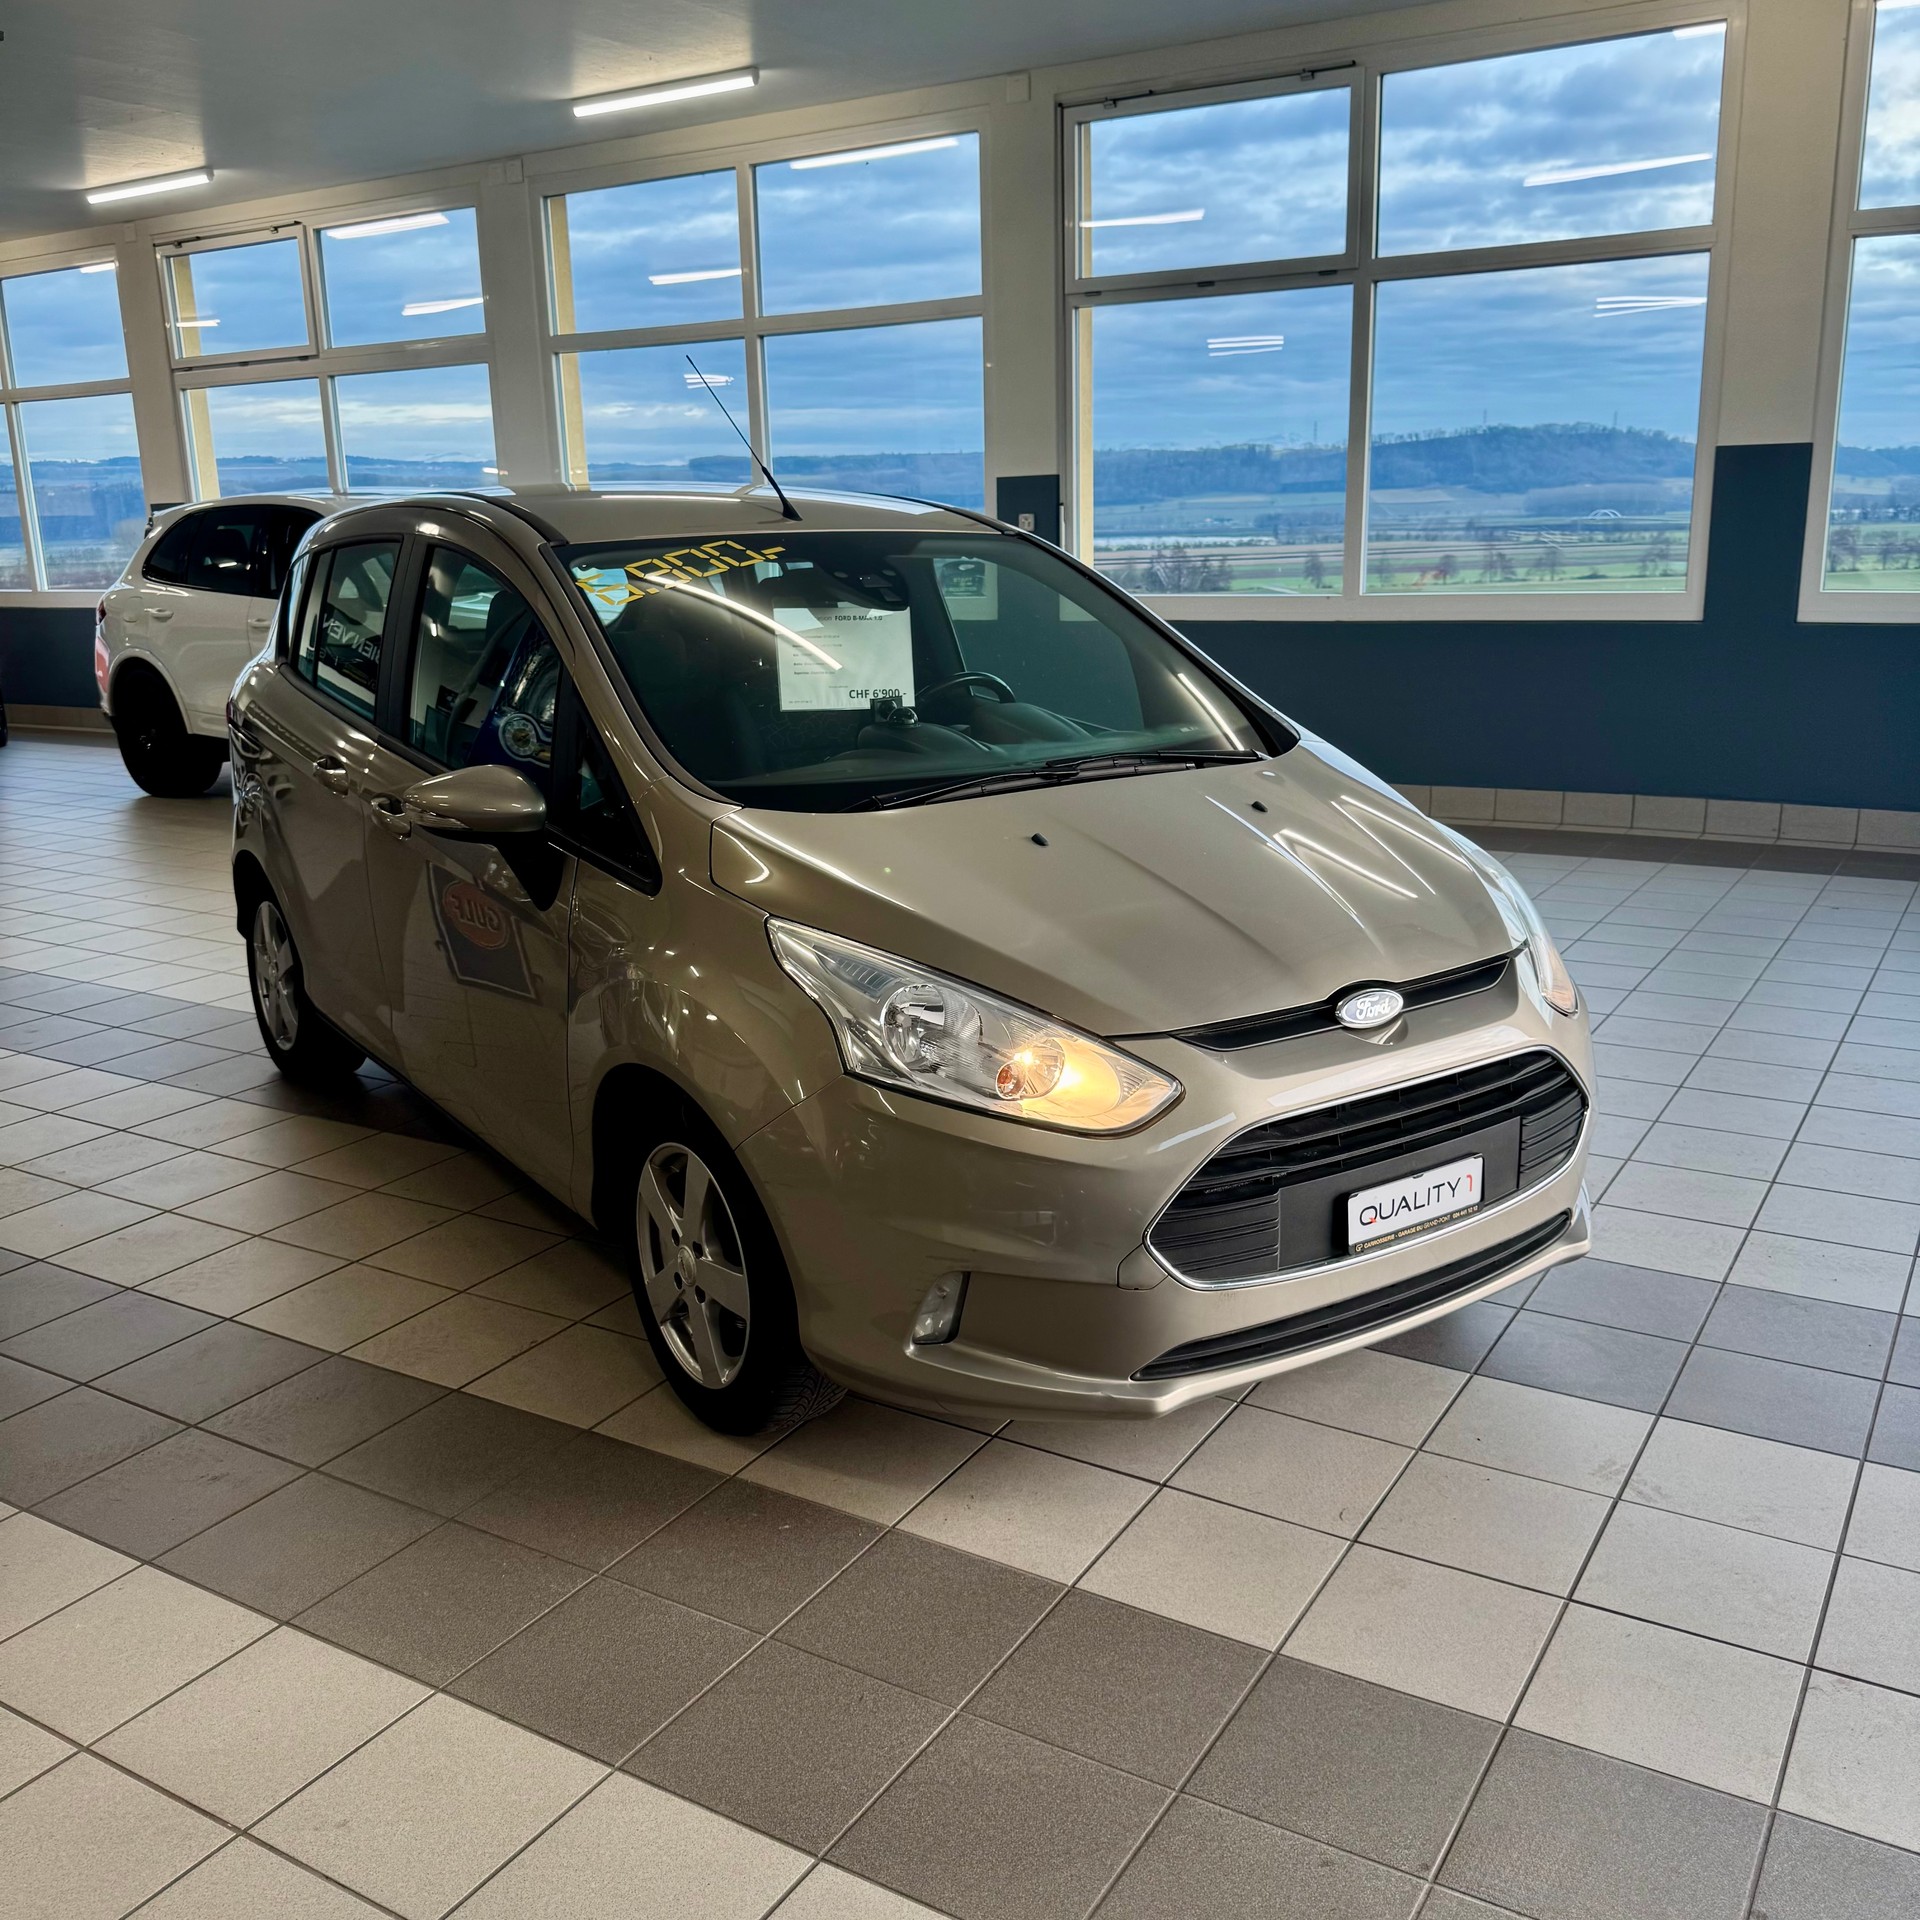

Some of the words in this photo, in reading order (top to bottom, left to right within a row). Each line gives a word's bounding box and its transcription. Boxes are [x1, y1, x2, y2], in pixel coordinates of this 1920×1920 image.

[849, 689, 870, 699] CHF
[1355, 995, 1391, 1020] Ford
[1359, 1177, 1462, 1226] QUALITY
[1363, 1234, 1395, 1249] CARROSSERIE
[1397, 1227, 1416, 1238] GARAGE
[1416, 1224, 1423, 1232] DU
[1424, 1215, 1451, 1229] GRAND-PONT
